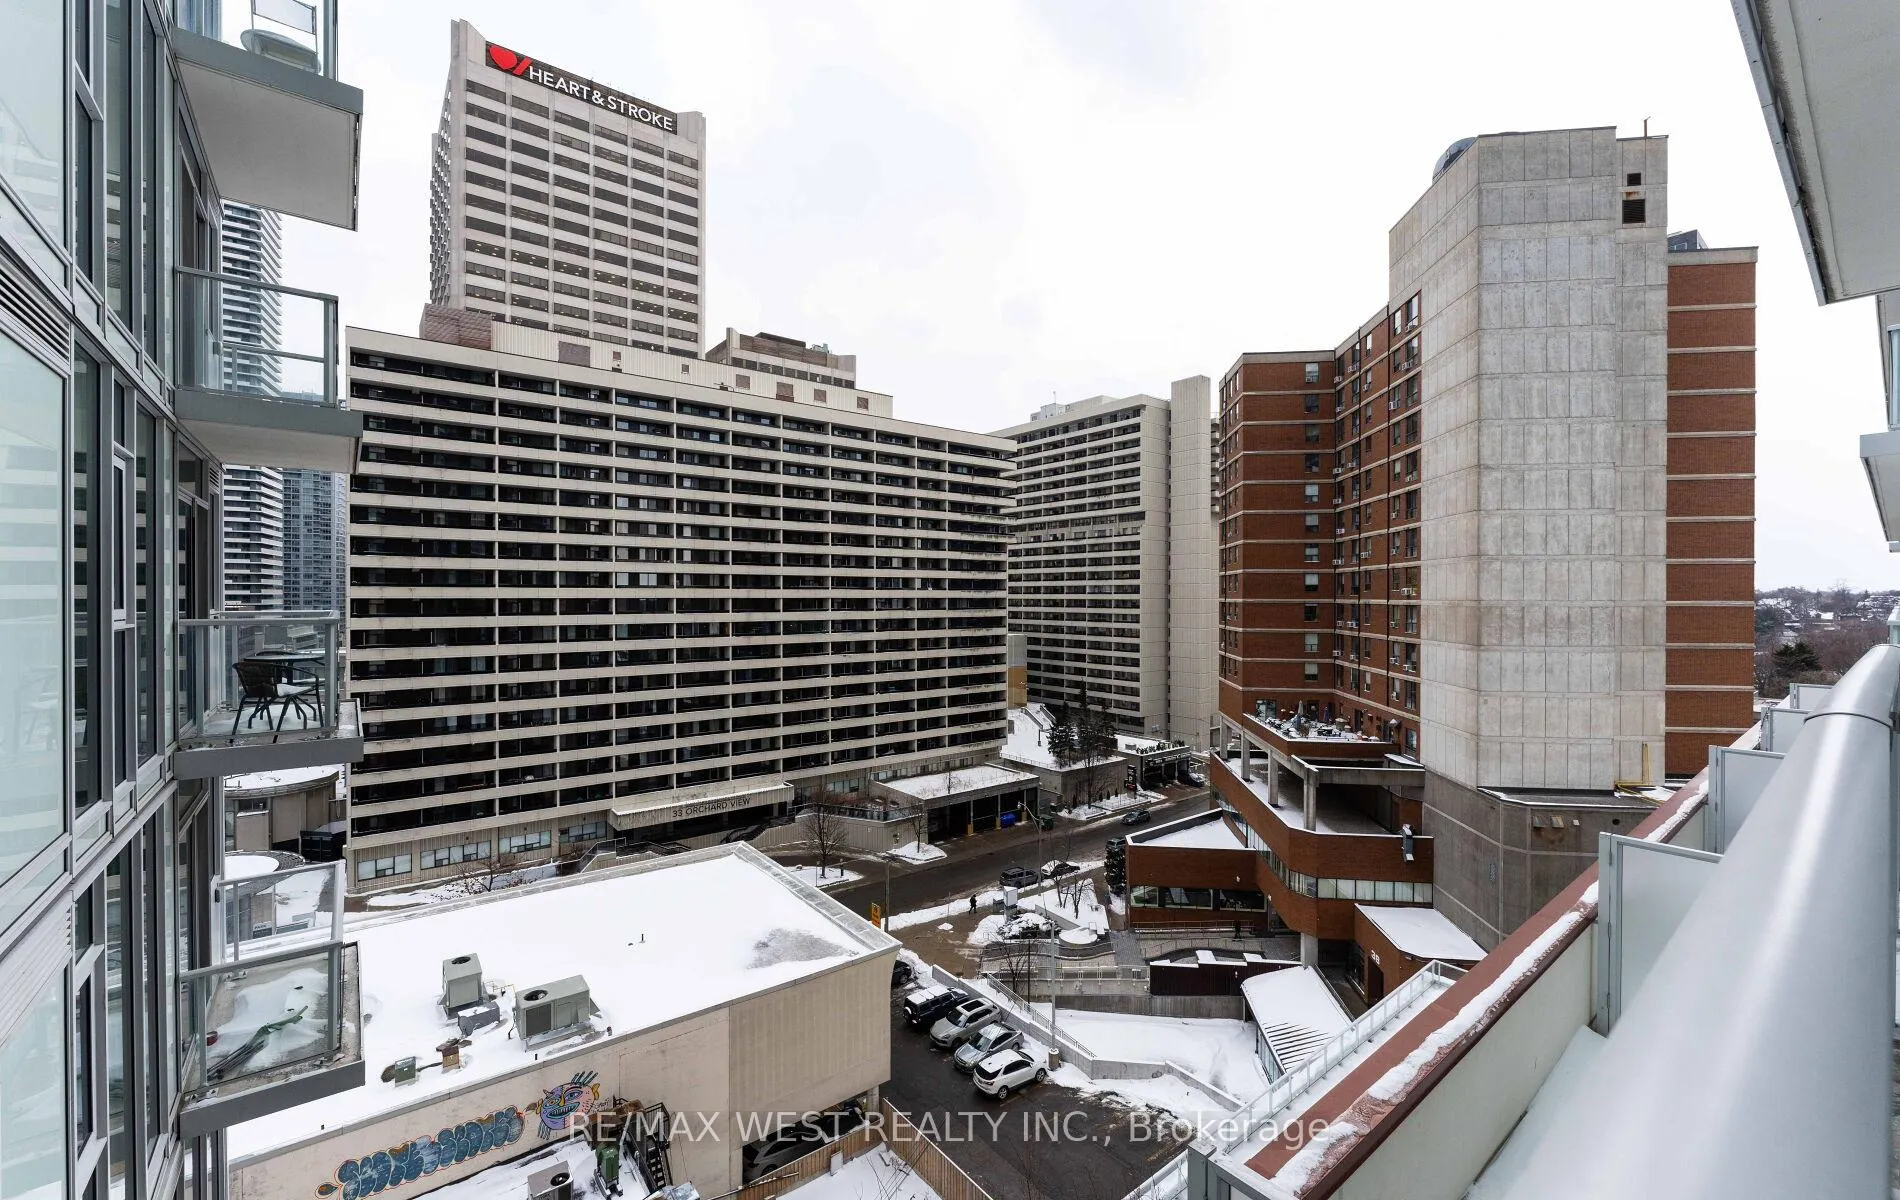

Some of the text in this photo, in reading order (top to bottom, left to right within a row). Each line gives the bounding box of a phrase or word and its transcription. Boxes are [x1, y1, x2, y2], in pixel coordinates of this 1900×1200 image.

[529, 65, 673, 131] HEART & STROKE
[672, 797, 751, 818] 33 ORCHARD VIEW
